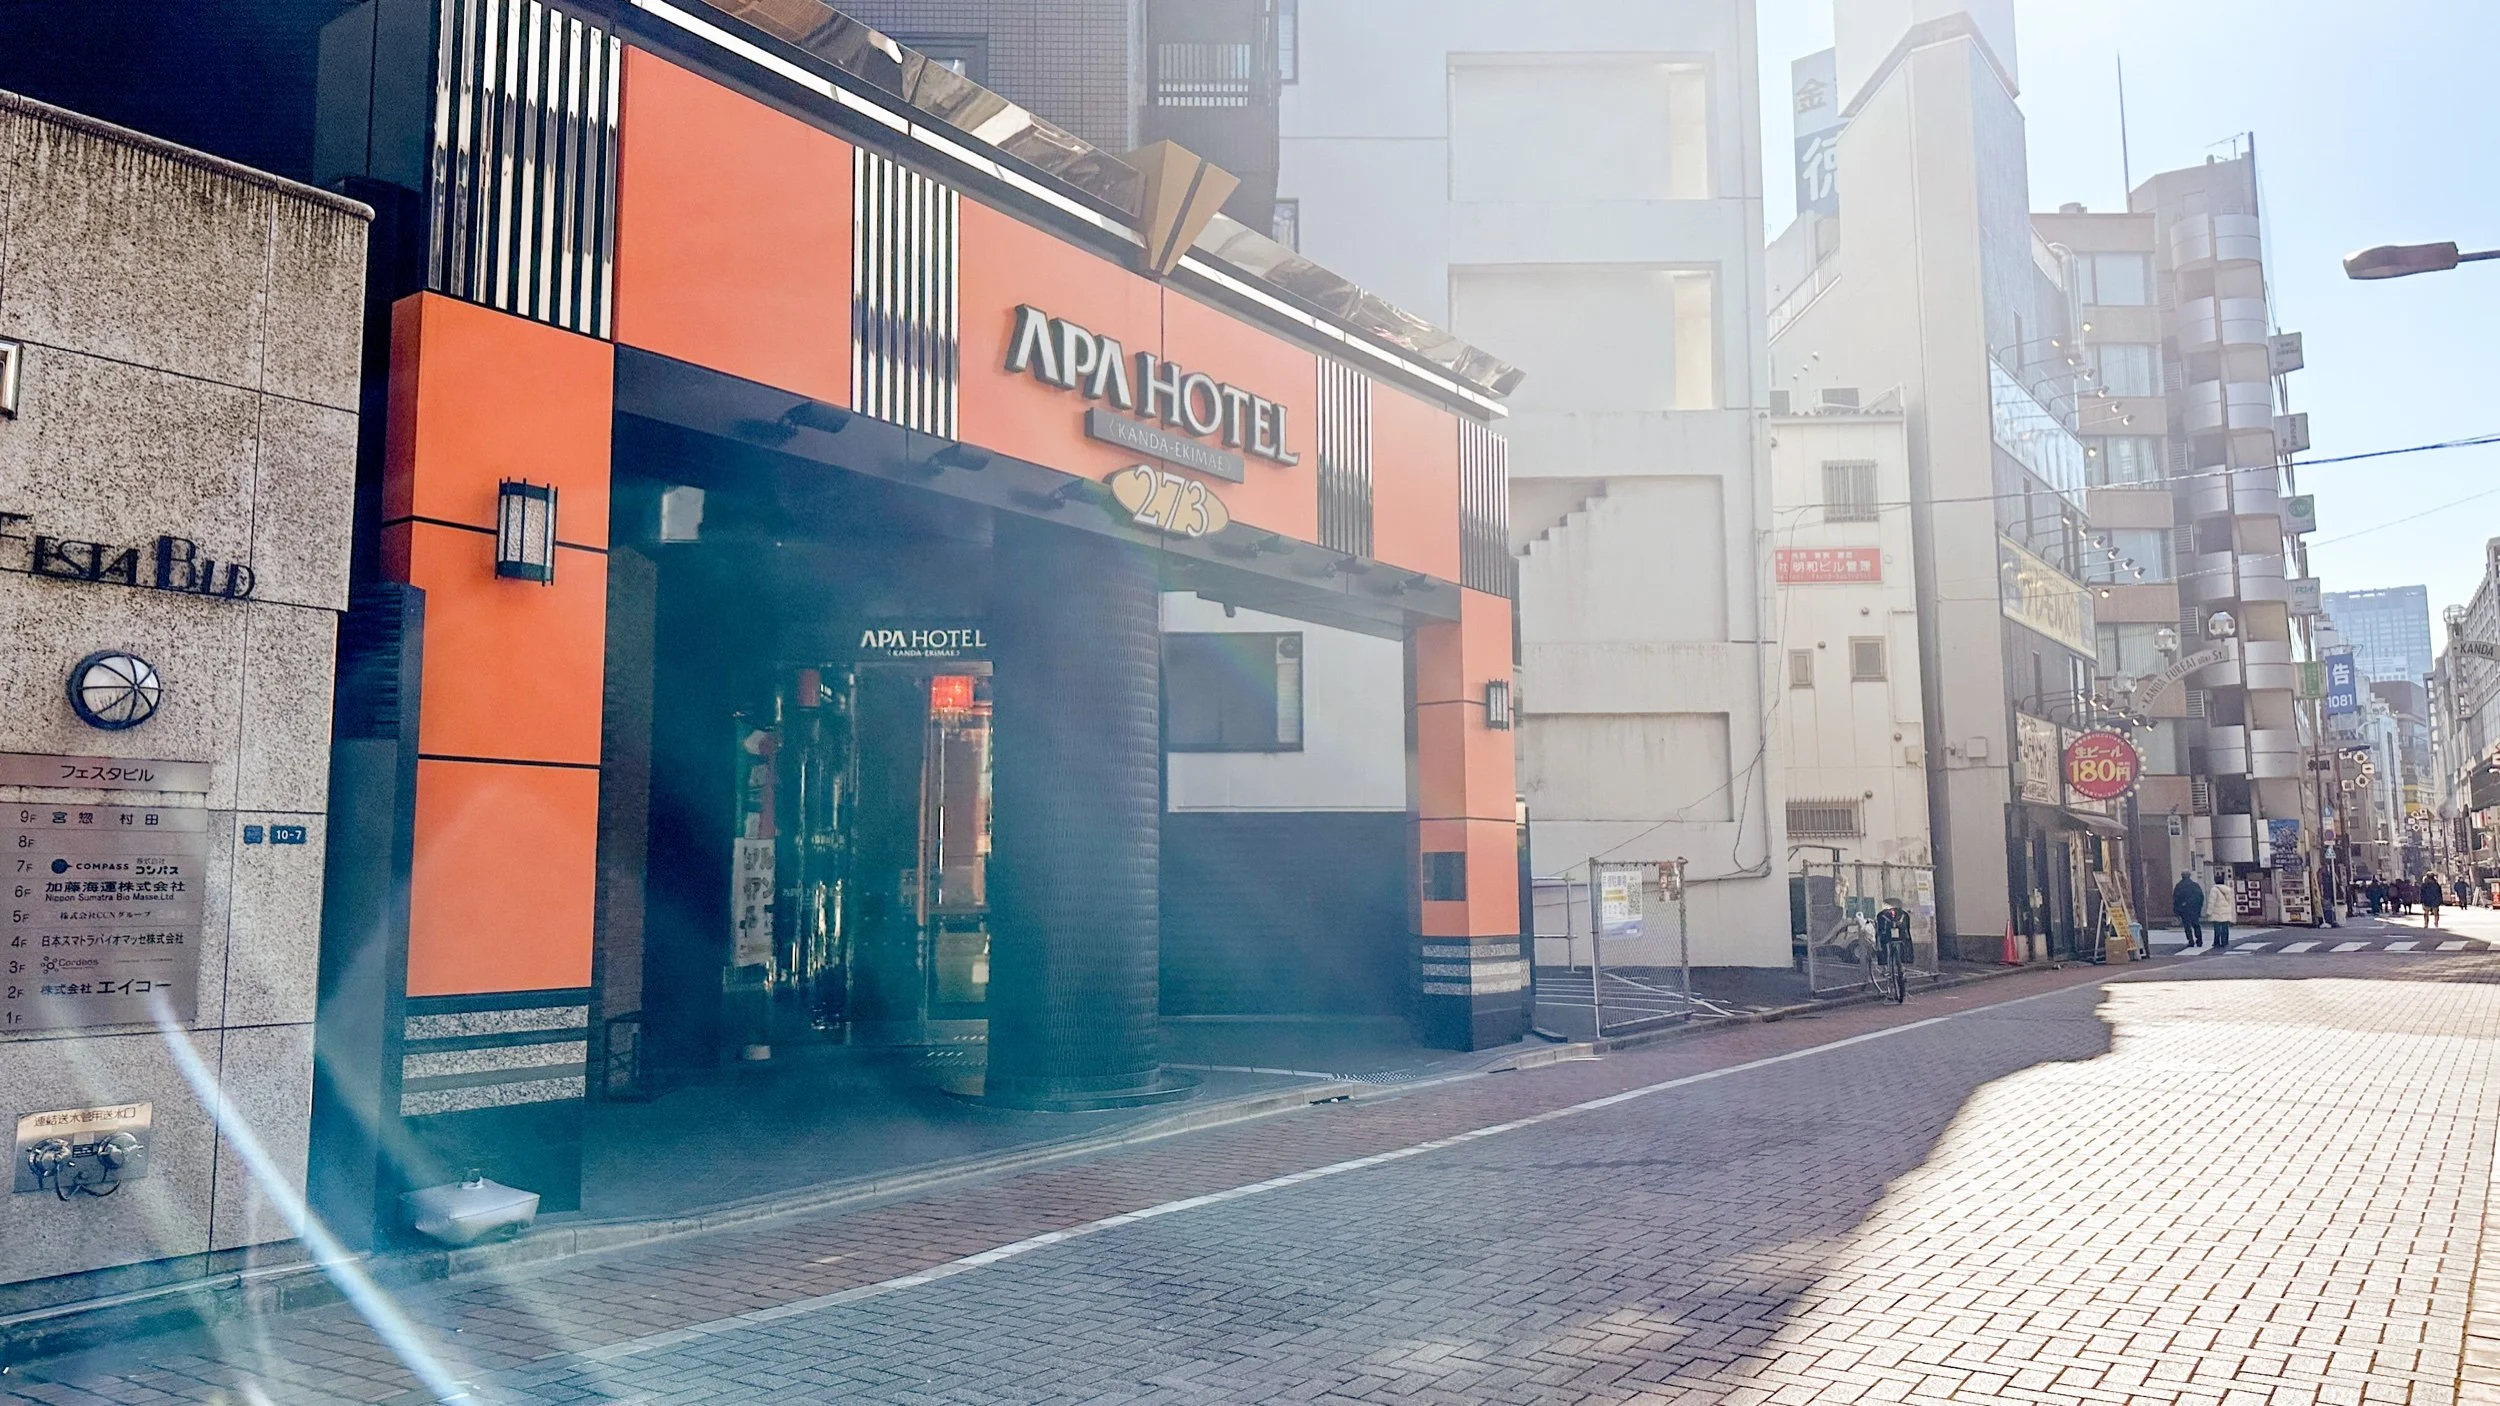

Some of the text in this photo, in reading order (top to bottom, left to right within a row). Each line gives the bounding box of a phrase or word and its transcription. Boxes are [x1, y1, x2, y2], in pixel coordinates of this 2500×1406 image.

[1005, 303, 1300, 467] APA HOTEL
[1134, 464, 1210, 538] 273
[860, 628, 988, 648] APA HOTEL
[2460, 642, 2494, 657] KANDA
[2332, 662, 2350, 686] 告
[2327, 693, 2354, 709] 1081
[2074, 745, 2123, 760] 生ビール
[61, 764, 155, 782] フェスタビル
[2069, 758, 2131, 784] 180円
[20, 809, 37, 824] 9F
[18, 835, 36, 849] 8F
[276, 829, 302, 840] 10-7
[17, 859, 130, 873] 7F COMPASS
[135, 865, 179, 875] コンパス
[14, 880, 186, 898] 6F 加藤海運株式会社
[45, 893, 76, 902] Nippon
[78, 892, 114, 901] Sumatra
[116, 892, 131, 901] Bio
[13, 910, 30, 924] 5F
[10, 932, 184, 949] 4F 日本スマトラバイオマッセ株式会社
[9, 960, 26, 974] 3F
[7, 978, 173, 999] 2F 株式会社 エイコー
[6, 1011, 23, 1024] 1F
